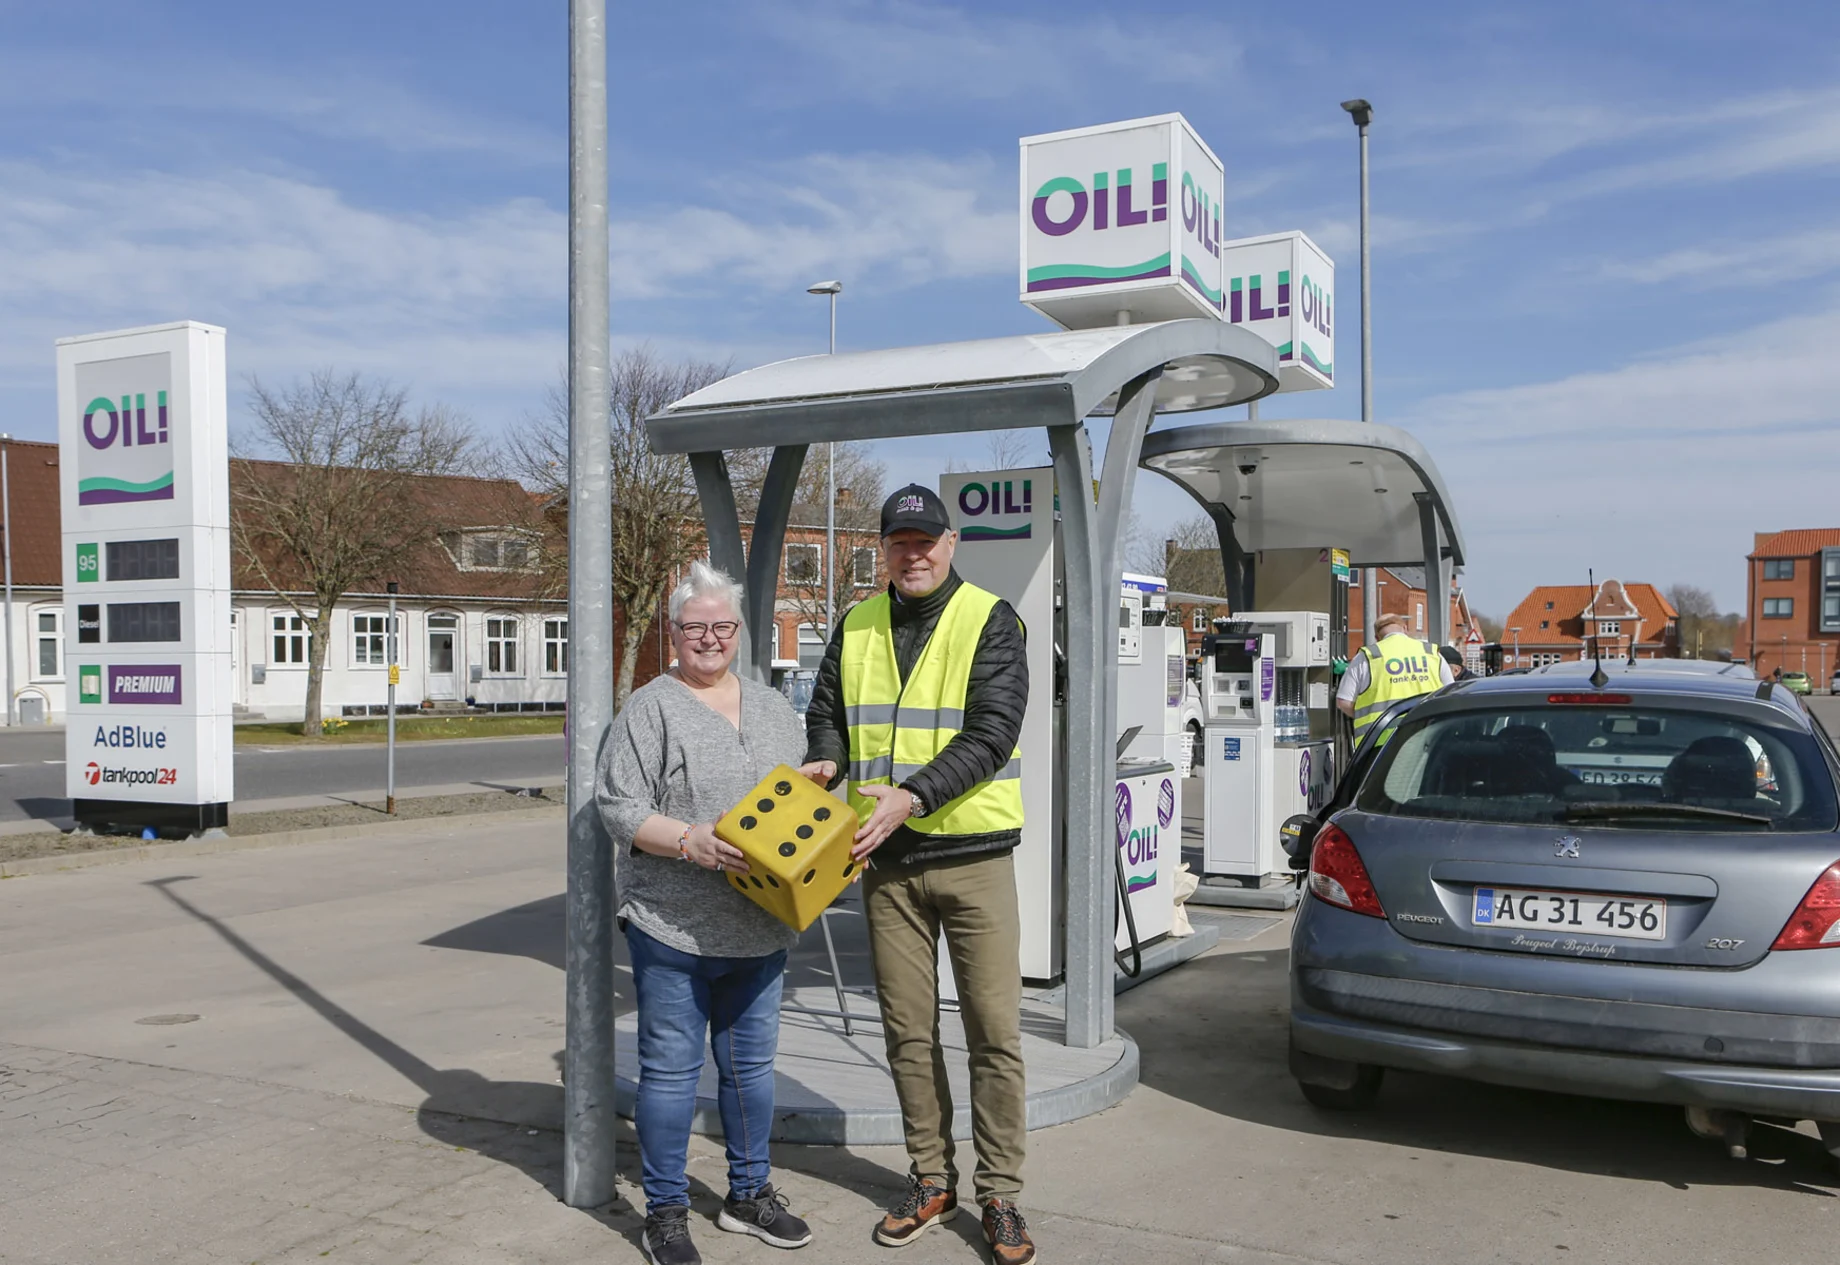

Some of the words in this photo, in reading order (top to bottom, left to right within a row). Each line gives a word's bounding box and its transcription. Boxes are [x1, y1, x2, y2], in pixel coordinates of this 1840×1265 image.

[1031, 162, 1168, 237] OIL!
[1181, 170, 1220, 259] OIL!
[1223, 270, 1290, 324] IL!
[1301, 274, 1331, 338] OIL!
[83, 390, 168, 450] OIL!
[958, 479, 1032, 516] OIL!
[79, 555, 97, 571] 95
[1319, 548, 1329, 563] 2
[1385, 656, 1428, 675] OIL!
[114, 675, 175, 694] PREMIUM
[94, 725, 166, 749] AdBlue
[102, 766, 177, 788] tankpool24
[1128, 824, 1158, 866] OIL!
[1396, 913, 1444, 925] PEUGEOT
[1477, 909, 1490, 918] DK
[1496, 894, 1539, 922] AG
[1548, 896, 1583, 926] 31
[1597, 900, 1658, 932] 456
[1511, 934, 1556, 952] Peugeot
[1705, 937, 1746, 951] 207
